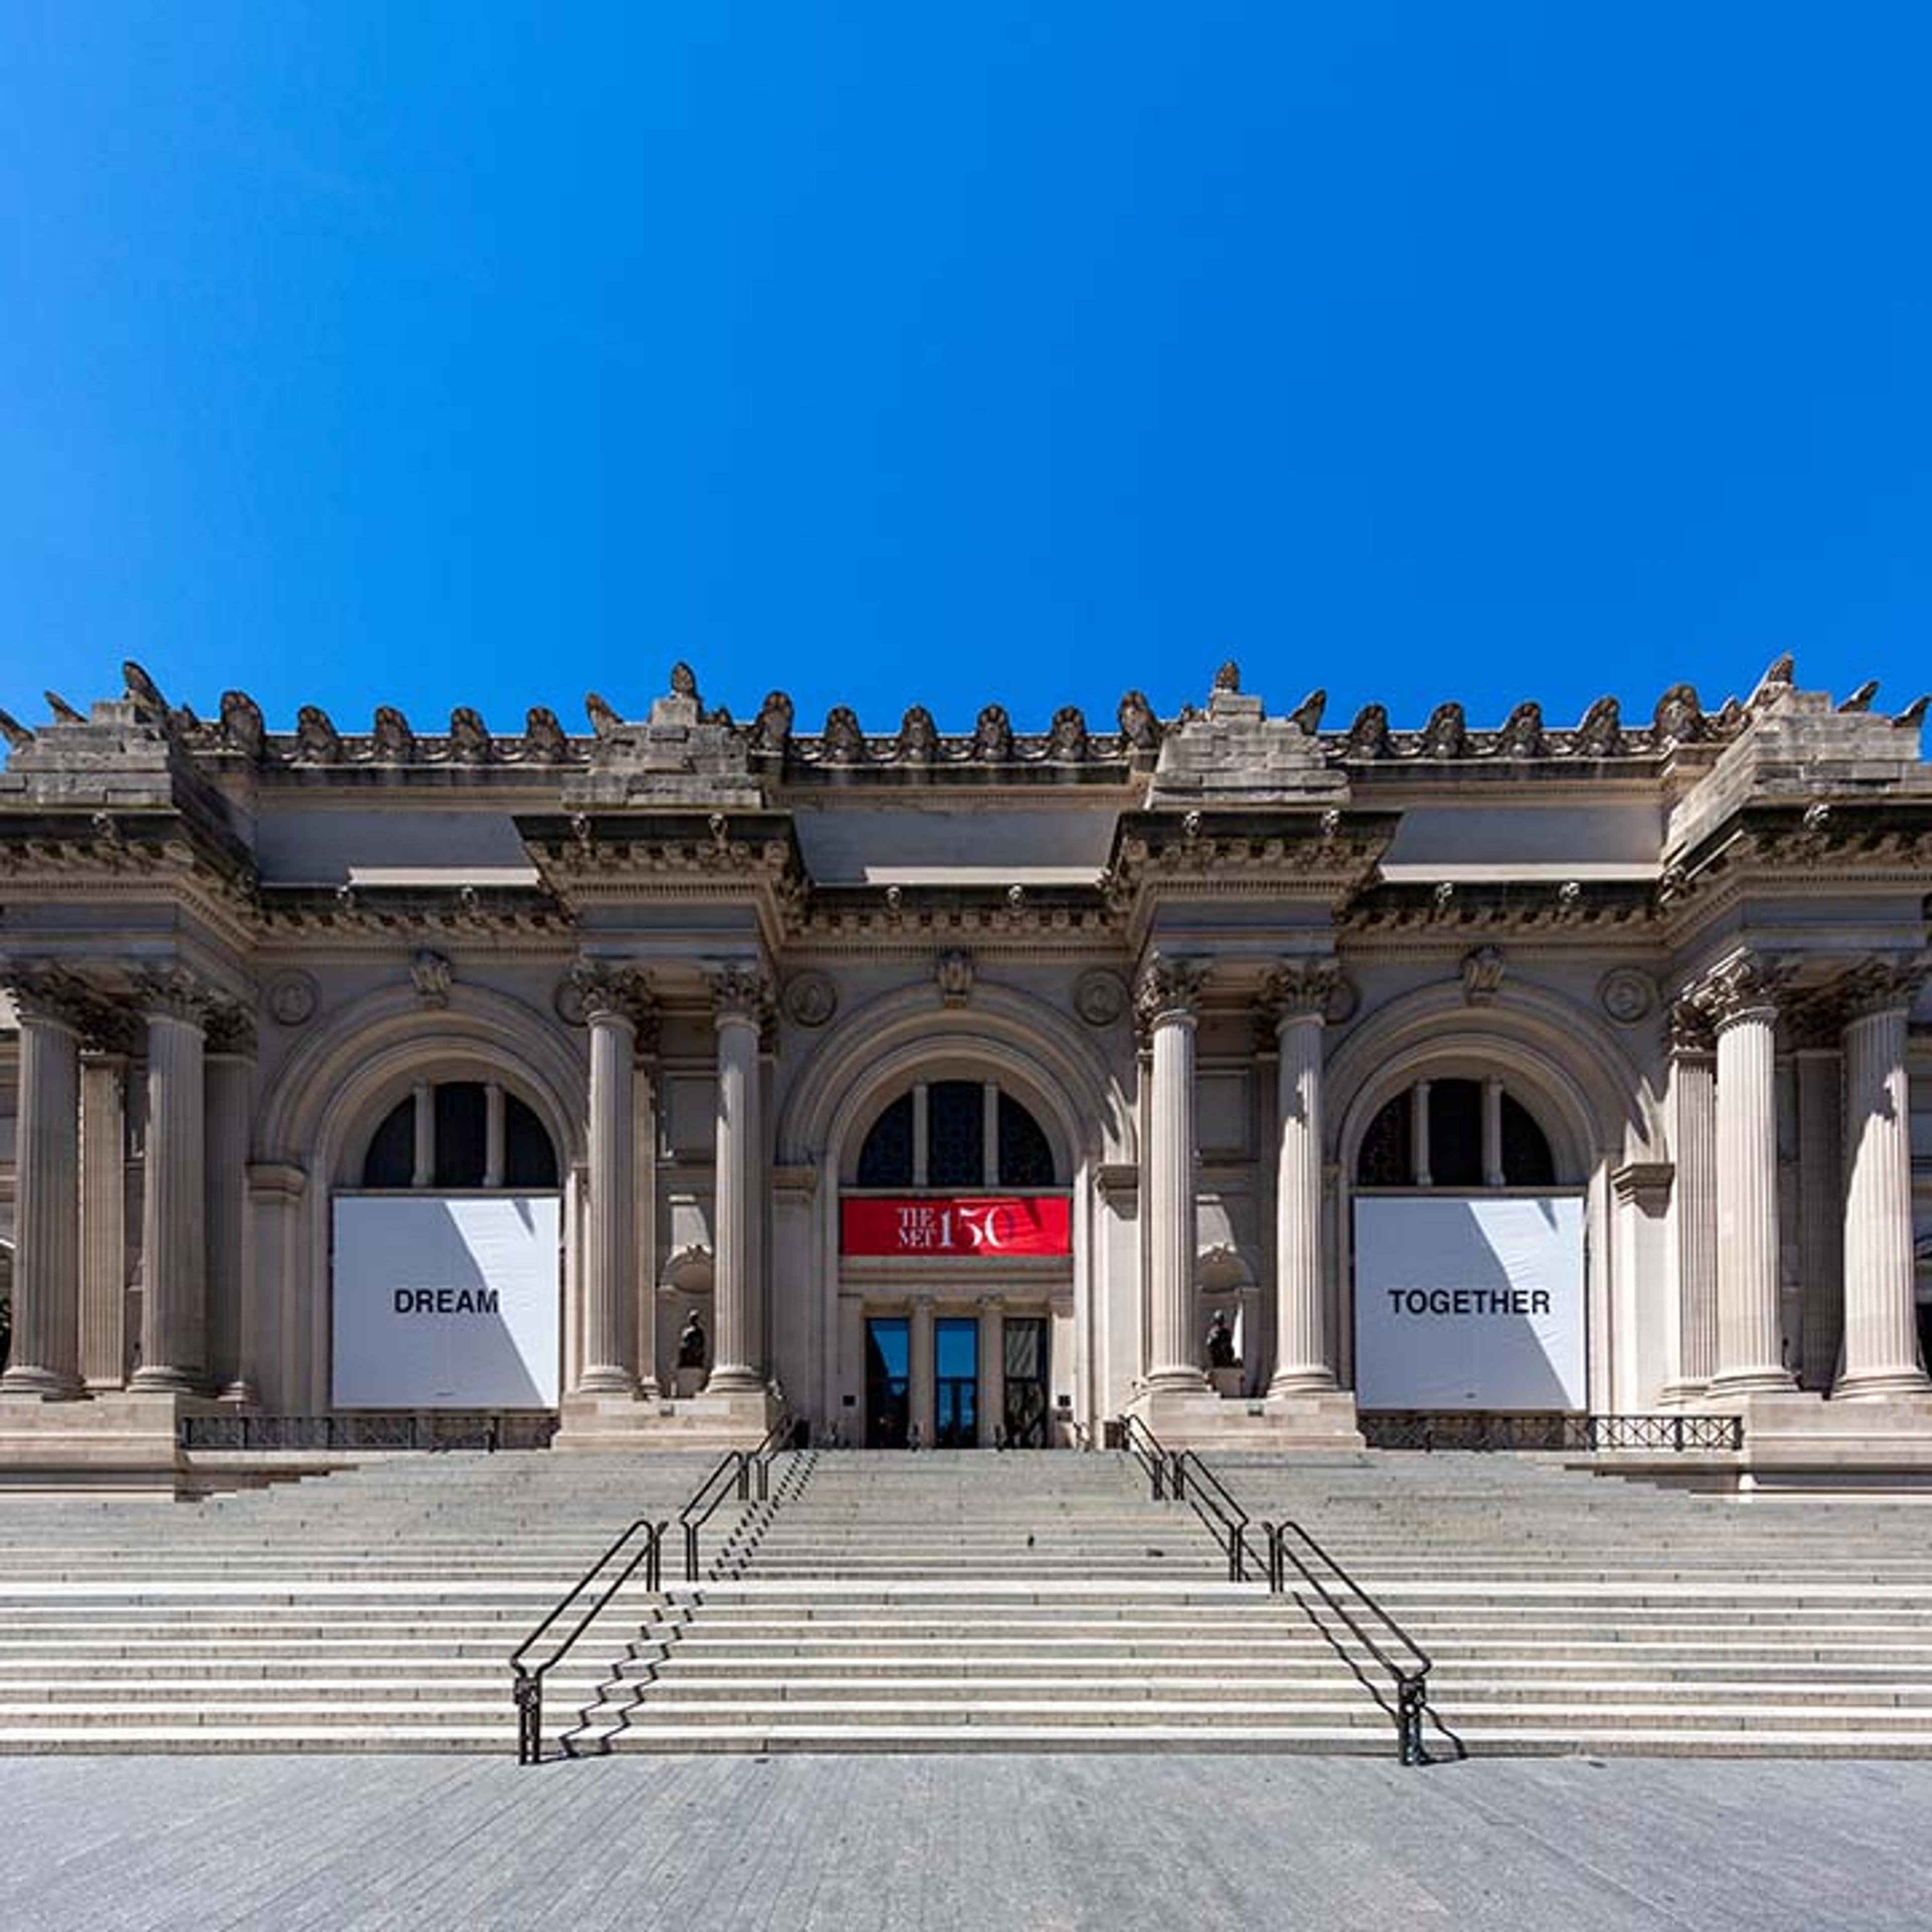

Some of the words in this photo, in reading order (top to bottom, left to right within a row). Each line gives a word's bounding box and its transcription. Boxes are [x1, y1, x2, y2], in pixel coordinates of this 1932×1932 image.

[939, 1206, 1012, 1247] 150
[394, 1289, 499, 1313] DREAM
[1389, 1289, 1550, 1314] TOGETHER
